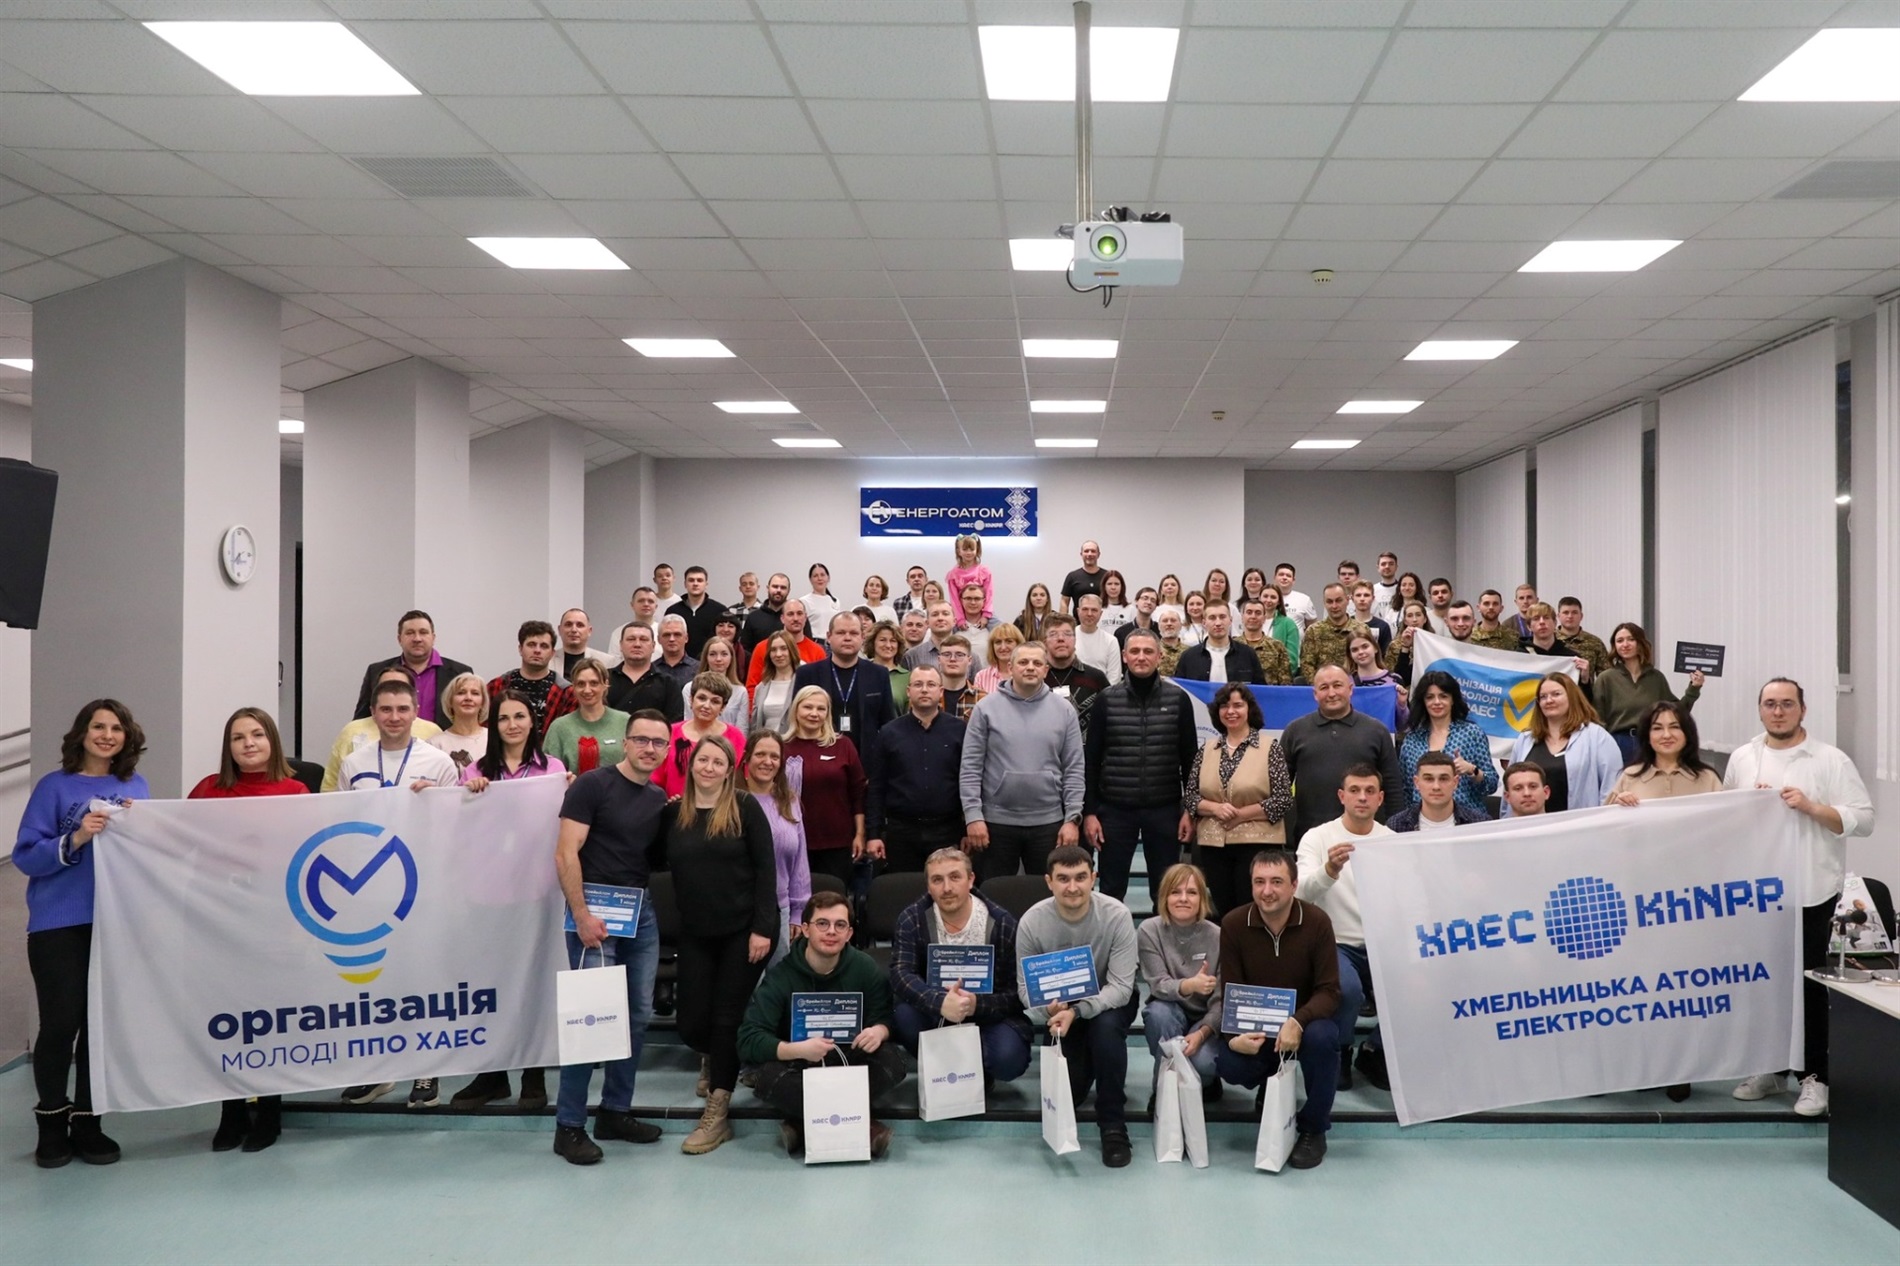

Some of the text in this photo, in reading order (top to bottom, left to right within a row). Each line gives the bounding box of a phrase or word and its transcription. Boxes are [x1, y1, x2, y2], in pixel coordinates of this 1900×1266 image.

[895, 507, 1004, 518] ЕНЕРГОАТОМ
[1454, 678, 1503, 695] АНІЗАЦІЯ
[1468, 703, 1498, 719] АЕС
[207, 982, 498, 1044] організація
[1452, 961, 1771, 1020] ХМЕЛЬНИЦЬКА АТОМНА
[1496, 993, 1732, 1041] ЕЛЕКТРОСТАНЦІЯ
[221, 1026, 487, 1073] МОЛОДІ ППО ХАЕС
